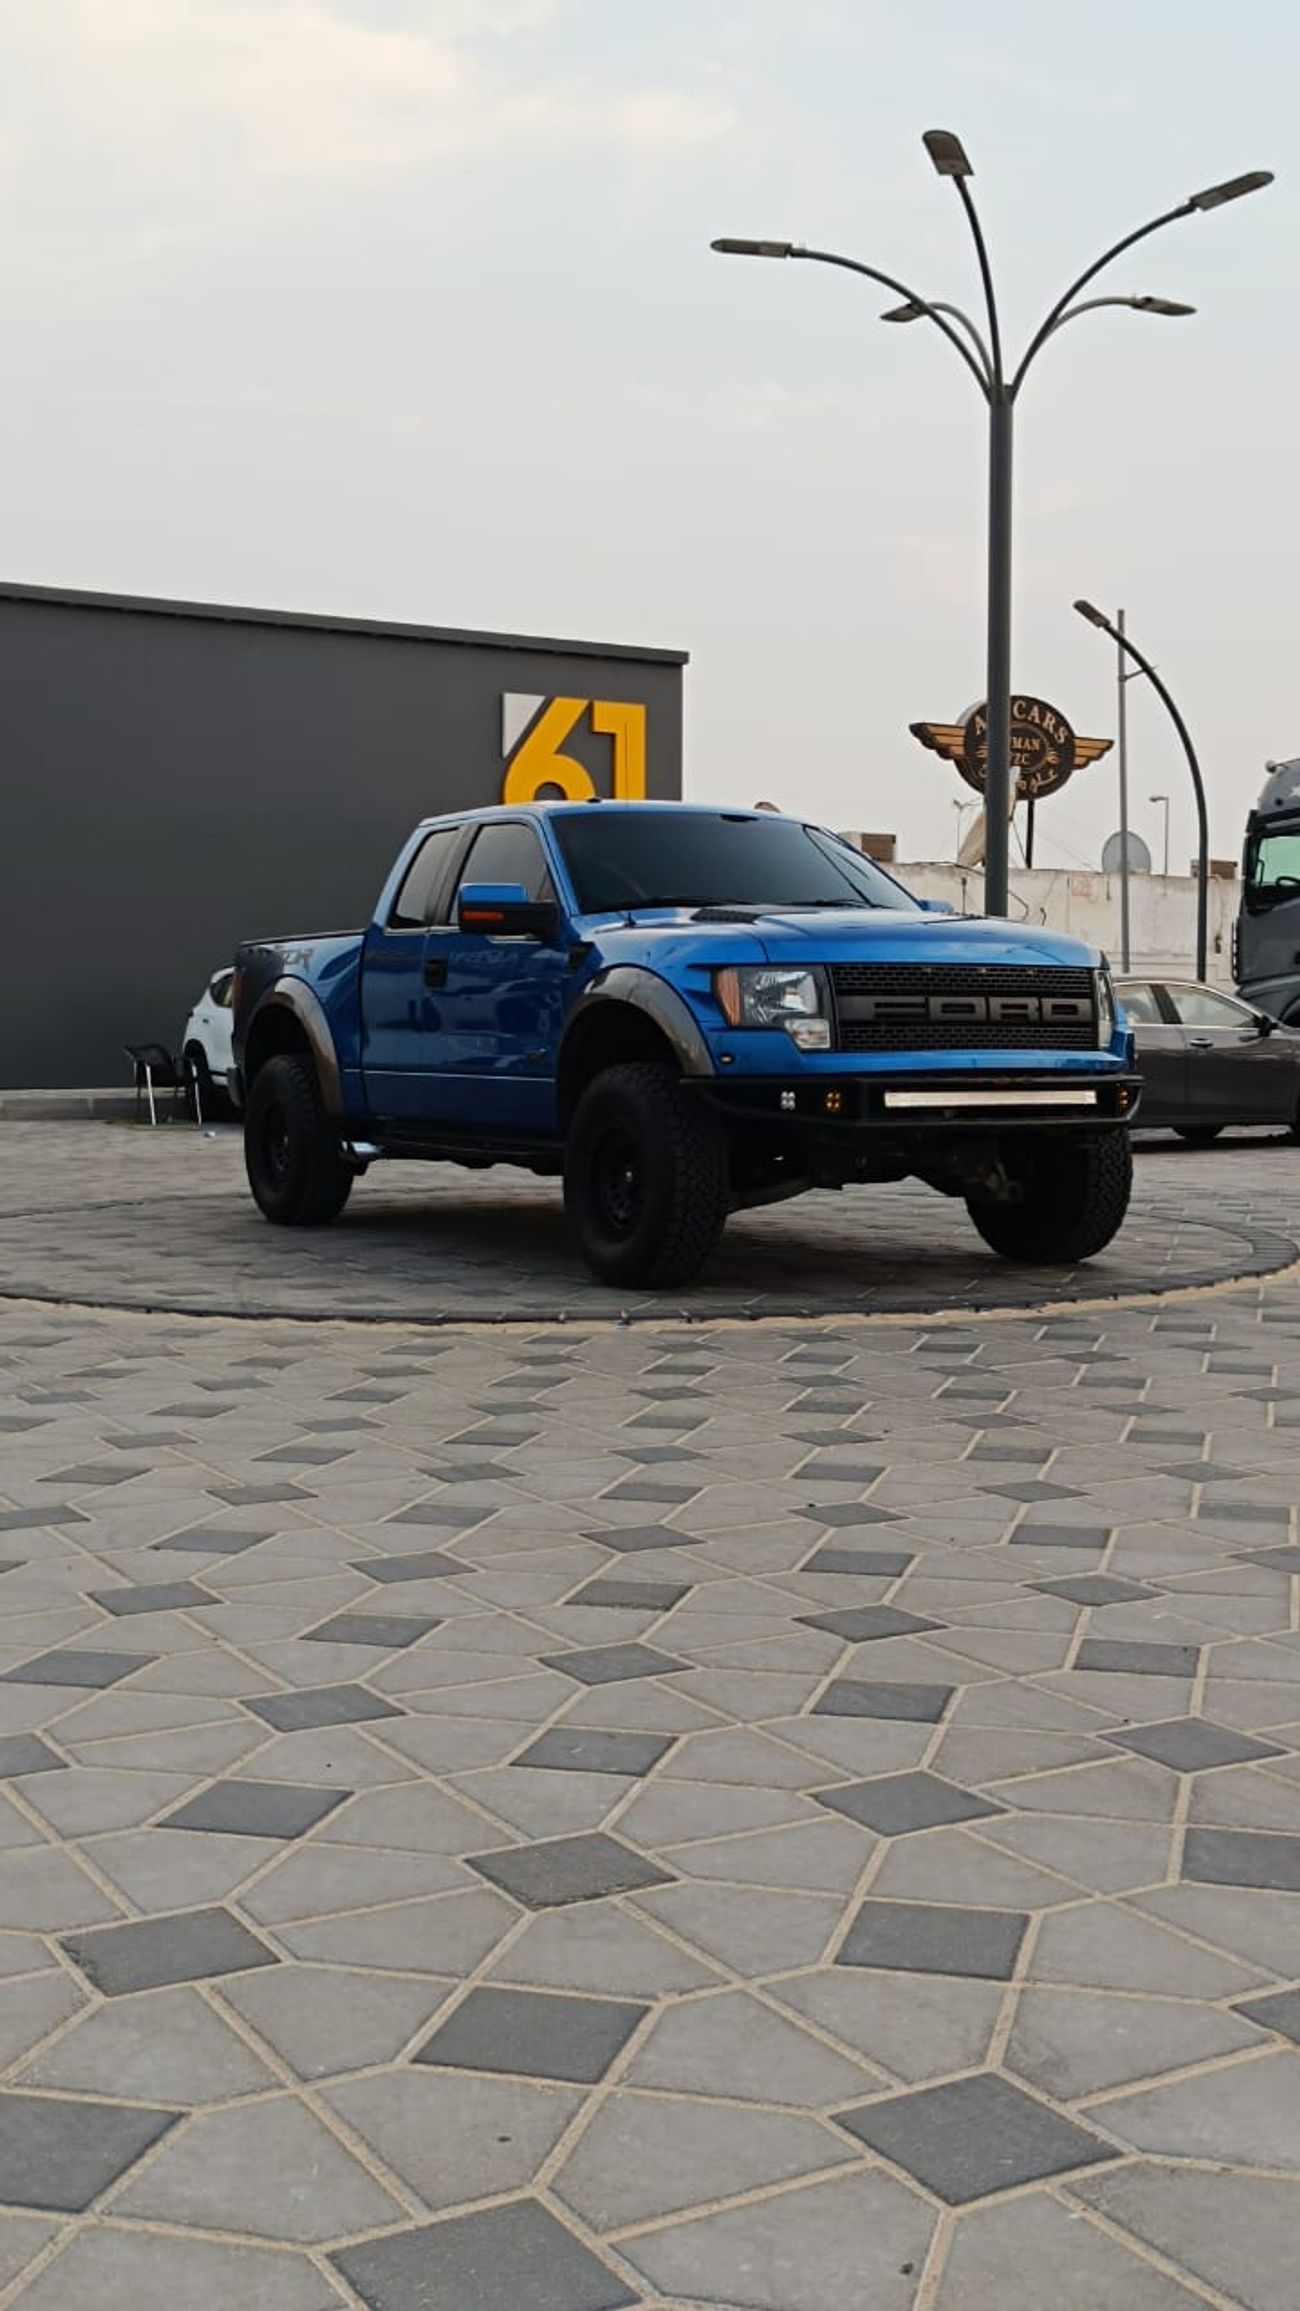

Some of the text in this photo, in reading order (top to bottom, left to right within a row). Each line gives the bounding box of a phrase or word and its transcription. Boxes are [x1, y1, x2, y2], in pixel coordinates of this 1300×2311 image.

[1012, 700, 1068, 743] CARS
[504, 697, 646, 804] 61
[1011, 736, 1040, 750] MAN
[1012, 753, 1029, 765] ZC
[837, 995, 1093, 1022] FORD
